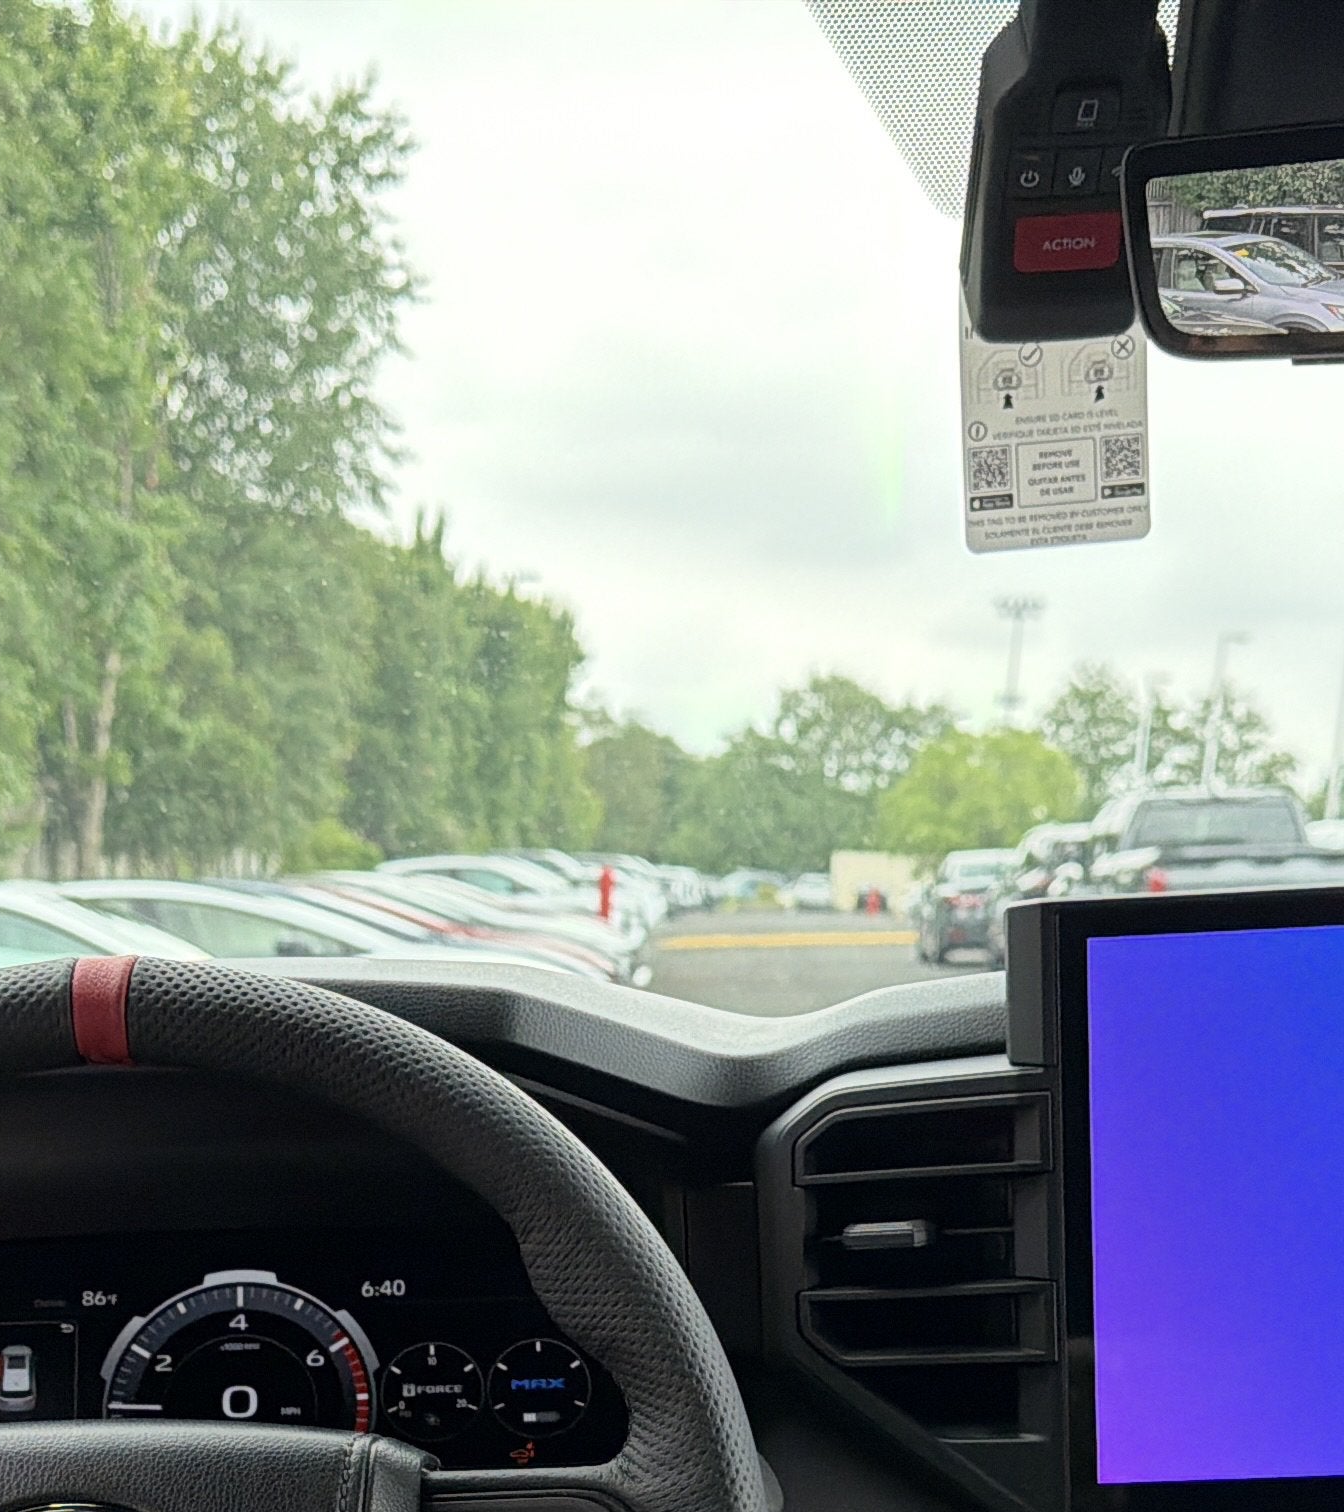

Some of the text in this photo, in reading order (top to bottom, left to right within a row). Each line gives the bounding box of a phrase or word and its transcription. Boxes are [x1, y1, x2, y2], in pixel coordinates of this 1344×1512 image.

[1042, 237, 1097, 252] ACTION
[361, 1279, 406, 1298] 6:40
[228, 1313, 249, 1331] 4
[154, 1354, 173, 1372] 2
[305, 1349, 325, 1367] 6
[426, 1356, 438, 1366] 10
[510, 1377, 565, 1391] MAX
[221, 1385, 258, 1419] 0
[280, 1406, 302, 1416] MPH
